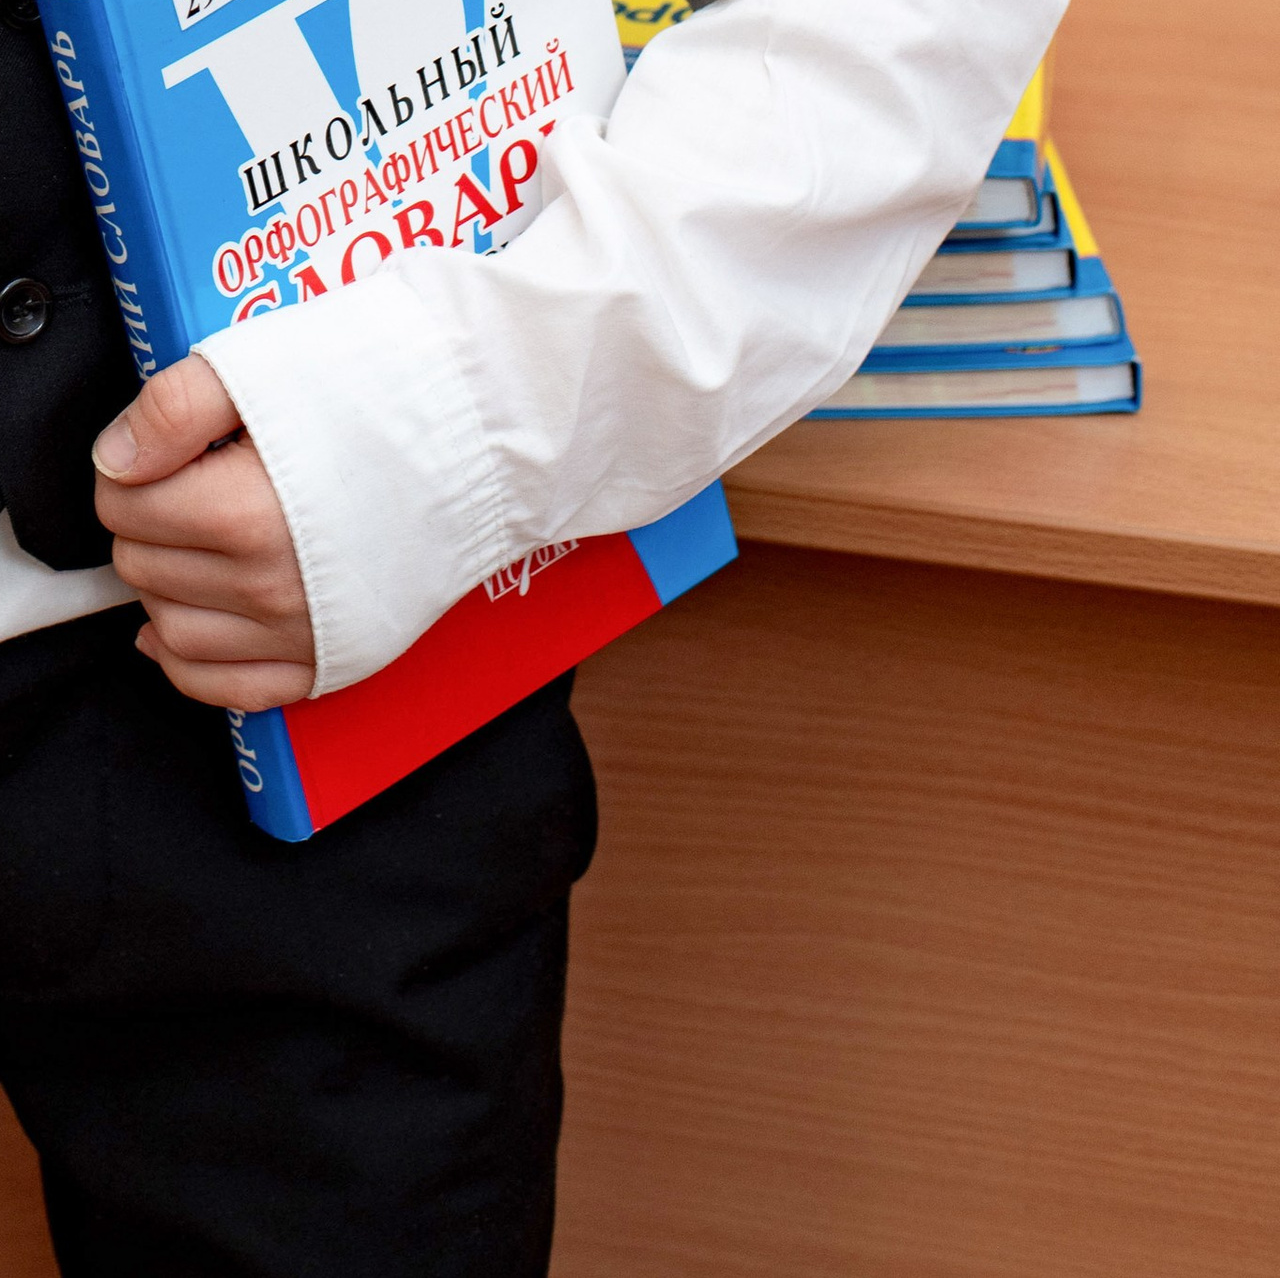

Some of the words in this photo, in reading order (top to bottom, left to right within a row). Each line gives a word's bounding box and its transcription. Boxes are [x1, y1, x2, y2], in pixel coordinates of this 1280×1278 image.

[50, 30, 129, 265] СЛОВАРЬ
[217, 37, 576, 294] ОРФОГРАФИЧЕСКИЙ
[242, 2, 521, 211] ШКОЛЬНЫЙ
[236, 119, 558, 324] ЛОВАР
